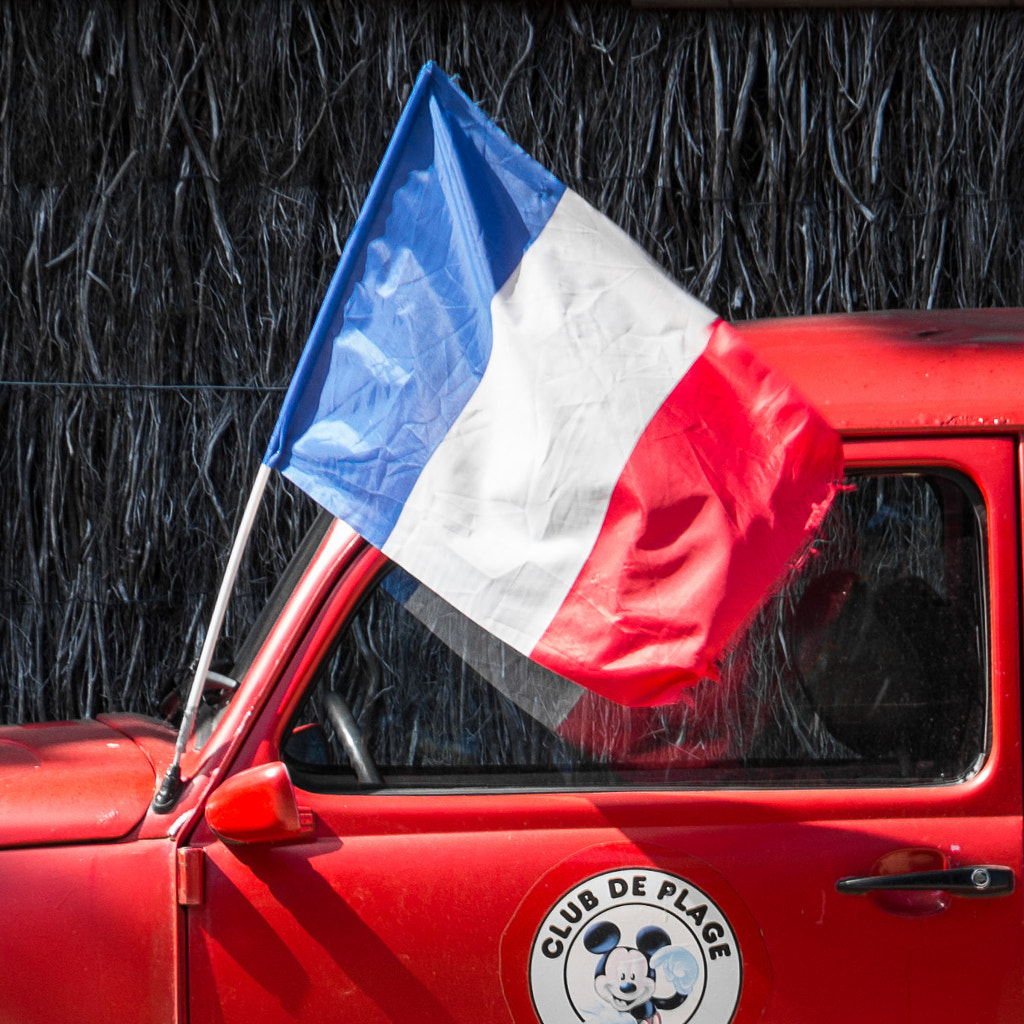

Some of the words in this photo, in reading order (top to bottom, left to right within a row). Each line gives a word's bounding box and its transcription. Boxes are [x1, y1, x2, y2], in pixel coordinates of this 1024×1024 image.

[541, 889, 600, 959] CLUB
[608, 875, 647, 898] DE
[657, 880, 731, 961] PLAGE
